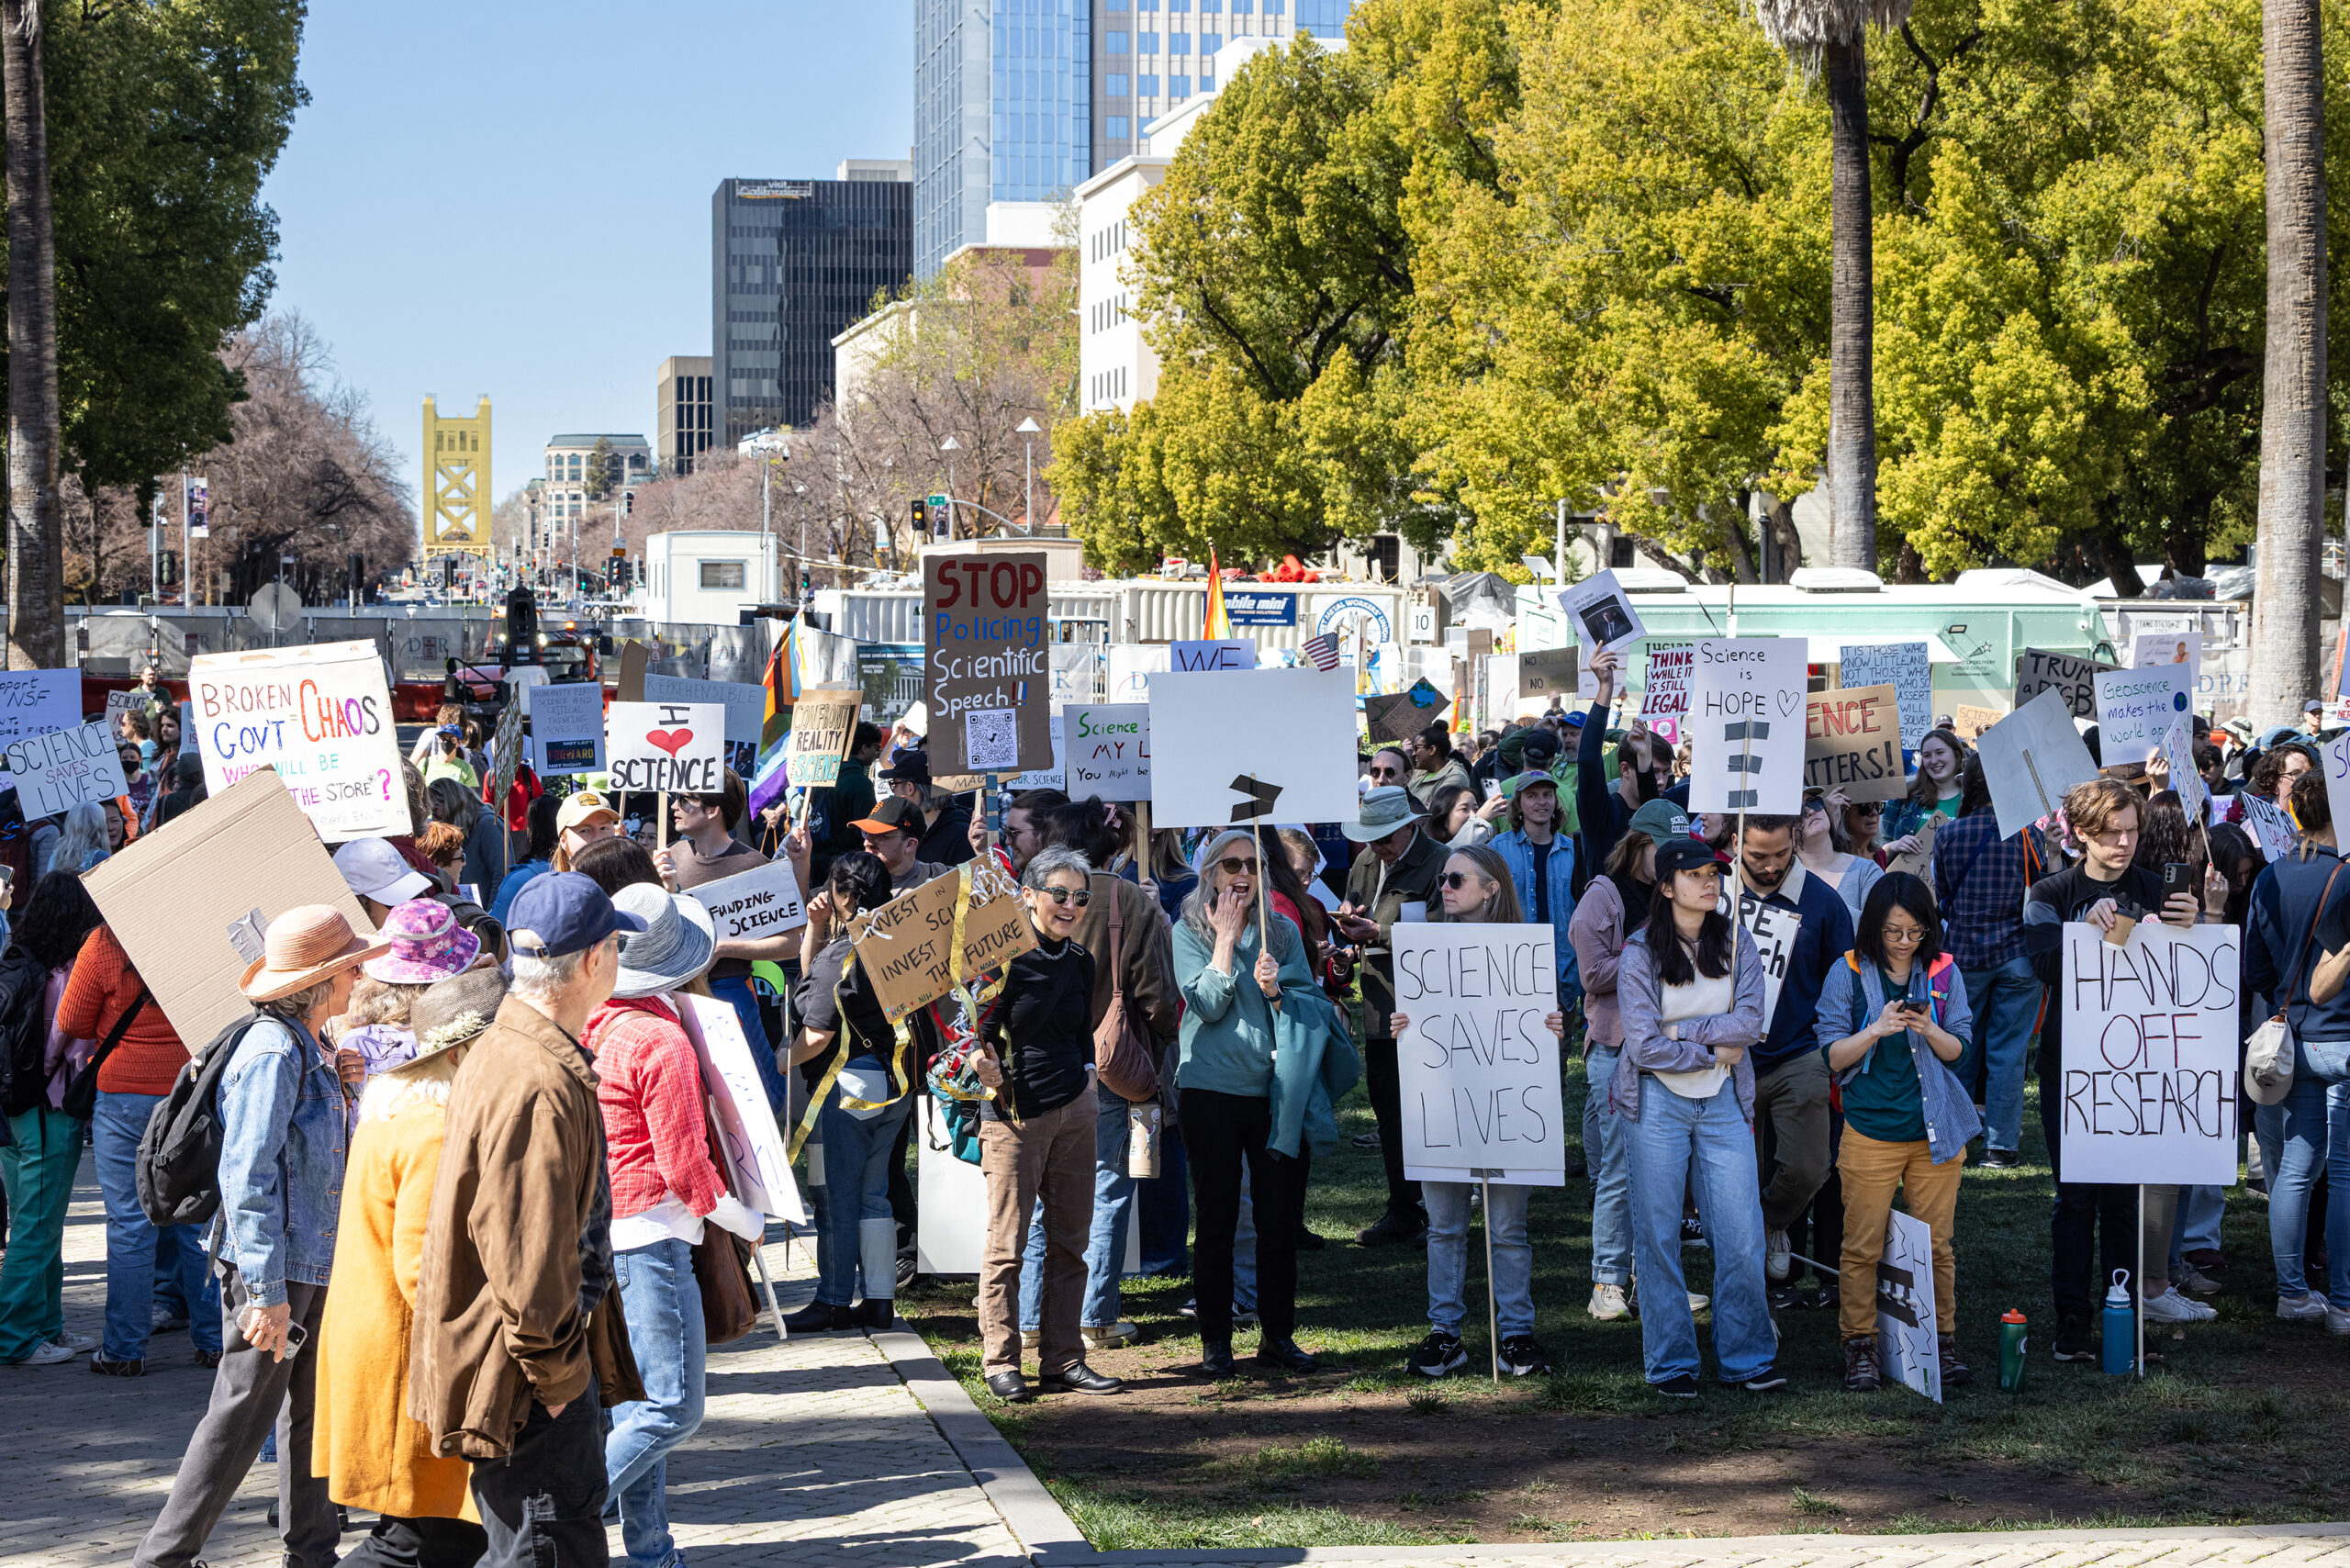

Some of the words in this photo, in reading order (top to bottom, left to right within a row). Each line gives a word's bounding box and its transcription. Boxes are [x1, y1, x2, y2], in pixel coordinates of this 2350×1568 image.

[740, 185, 799, 196] California
[768, 181, 788, 189] visit
[936, 560, 1044, 609] STOP
[1257, 597, 1290, 610] mini
[936, 612, 1041, 647] Policing
[1324, 600, 1347, 622] METAL
[1379, 615, 1391, 644] UNION
[1416, 614, 1429, 631] 10
[1651, 651, 1694, 669] THINK
[1701, 643, 1765, 664] Science
[1841, 645, 1852, 656] IT
[1853, 645, 1864, 656] IS
[1866, 645, 1899, 655] THOSE
[1903, 643, 1928, 654] WHO
[934, 645, 1046, 683] Scientific
[1524, 655, 1537, 667] NO
[1841, 656, 1871, 668] KNOW
[1529, 678, 1544, 690] NO
[1651, 667, 1683, 680] WHILE
[1684, 666, 1694, 678] IT
[1740, 667, 1752, 680] is
[1841, 668, 1862, 680] NOT
[1869, 666, 1903, 678] THOSE
[1907, 666, 1930, 678] WHO
[1897, 678, 1919, 690] WHO
[1919, 678, 1930, 688] SO
[1648, 682, 1658, 693] IS
[1661, 679, 1686, 692] STILL
[1897, 690, 1931, 701] ASSERT
[2022, 683, 2031, 694] a
[2103, 679, 2172, 700] Geoscience
[7, 690, 51, 708] NSF
[201, 683, 292, 718] BROKEN
[1641, 691, 1689, 714] LEGAL
[1707, 689, 1766, 717] HOPE
[1899, 703, 1924, 713] WILL
[213, 720, 285, 760] GOV'T
[299, 678, 381, 743] CHAOS
[658, 705, 690, 725] I
[793, 703, 849, 731] CONFRONT
[1806, 697, 1881, 740] ENCE
[1903, 714, 1933, 725] SOLVED
[2108, 702, 2144, 721] makes
[2147, 701, 2167, 716] the
[576, 723, 590, 734] US
[1078, 711, 1139, 738] Science
[2110, 722, 2144, 743] world
[2151, 725, 2165, 745] go
[7, 720, 116, 776] SCIENCE
[796, 730, 843, 752] REALITY
[1091, 741, 1125, 760] MY
[319, 754, 340, 771] BE
[547, 748, 595, 761] FORWARD
[46, 759, 89, 785] SAVES
[610, 756, 717, 791] SCIENCE
[793, 754, 842, 783] SCIENCE
[1077, 767, 1102, 782] You
[1108, 767, 1129, 779] Might
[1136, 766, 1148, 777] be
[38, 767, 116, 814] LIVES
[1033, 774, 1063, 786] SCIENCE
[288, 788, 322, 807] THE
[2245, 793, 2282, 828] NIH
[708, 890, 776, 922] FUNDING
[861, 893, 920, 939] INVEST
[934, 885, 946, 898] IN
[729, 902, 799, 937] SCIENCE
[964, 919, 1024, 966] FUTURE
[879, 938, 937, 982] INVEST
[1400, 942, 1554, 1001] SCIENCE
[2073, 938, 2237, 1012] HANDS
[890, 1002, 907, 1018] NSF
[918, 991, 933, 1004] NIH
[979, 958, 998, 972] NOAA
[1419, 1008, 1540, 1069] SAVES
[2100, 1013, 2203, 1070] OFF
[2065, 1069, 2239, 1140] RESEARCH
[1420, 1085, 1547, 1148] LIVES
